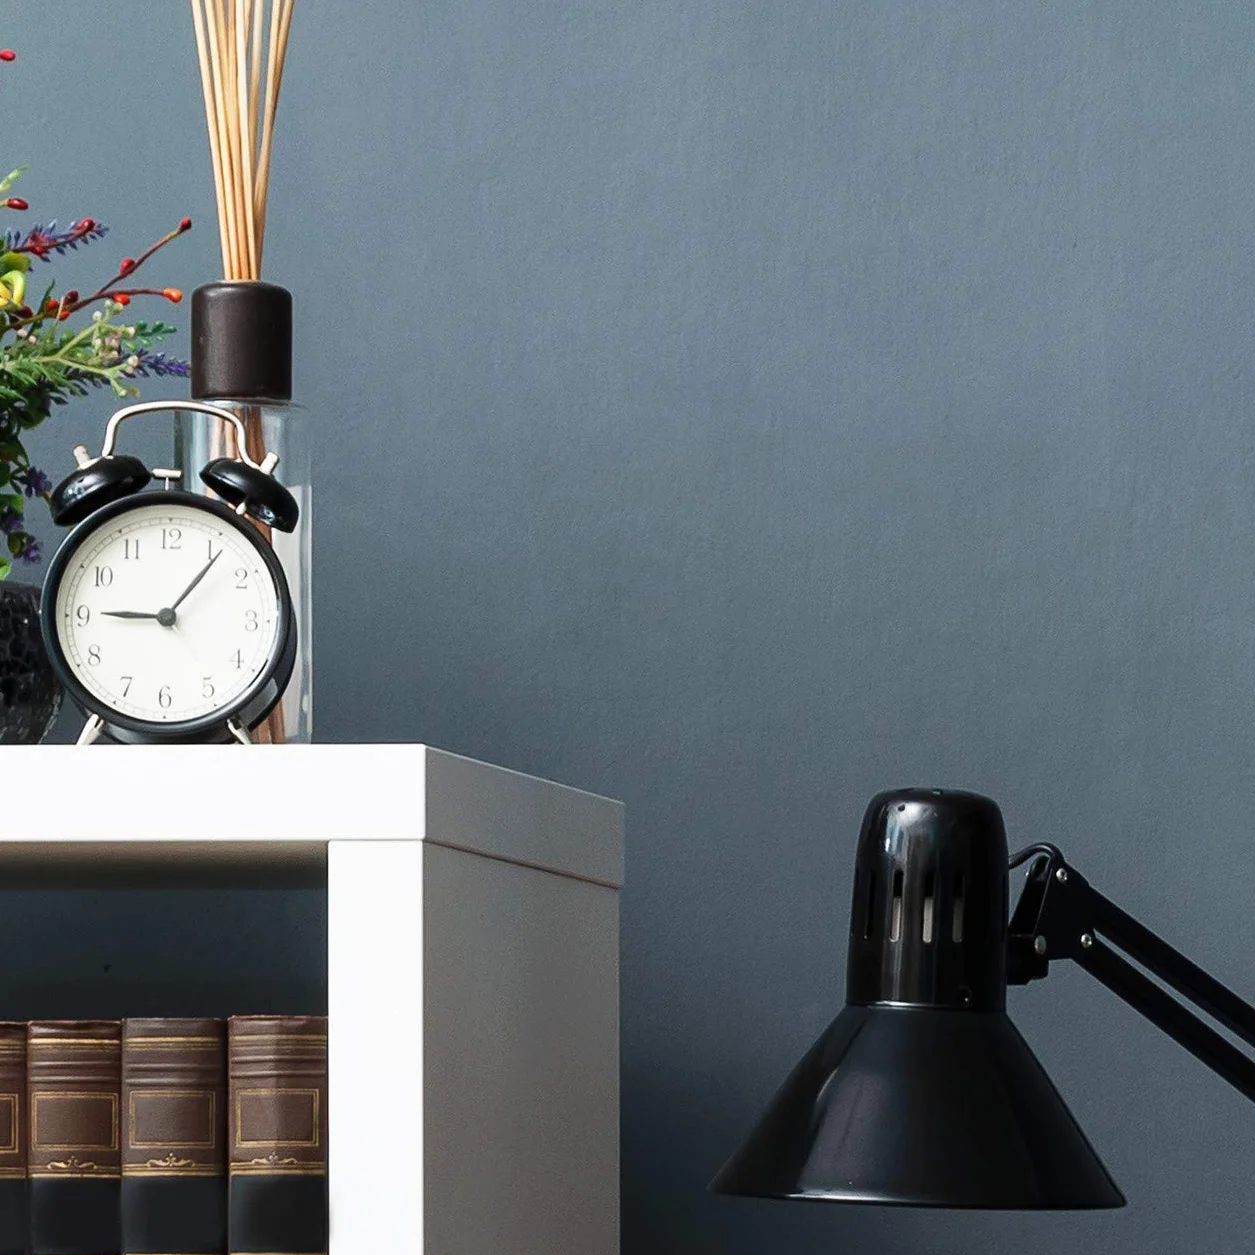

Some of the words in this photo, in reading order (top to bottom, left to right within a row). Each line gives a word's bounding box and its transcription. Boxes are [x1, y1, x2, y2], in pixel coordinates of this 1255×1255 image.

[124, 539, 140, 560] 11
[161, 528, 182, 550] 12
[207, 539, 213, 560] 1
[94, 565, 114, 587] 10
[235, 570, 248, 589] 2
[76, 605, 90, 627] 9
[245, 610, 258, 632] 3
[87, 644, 101, 666] 8
[229, 649, 244, 669] 4
[120, 676, 133, 698] 7
[158, 685, 172, 708] 6
[202, 677, 215, 698] 5
